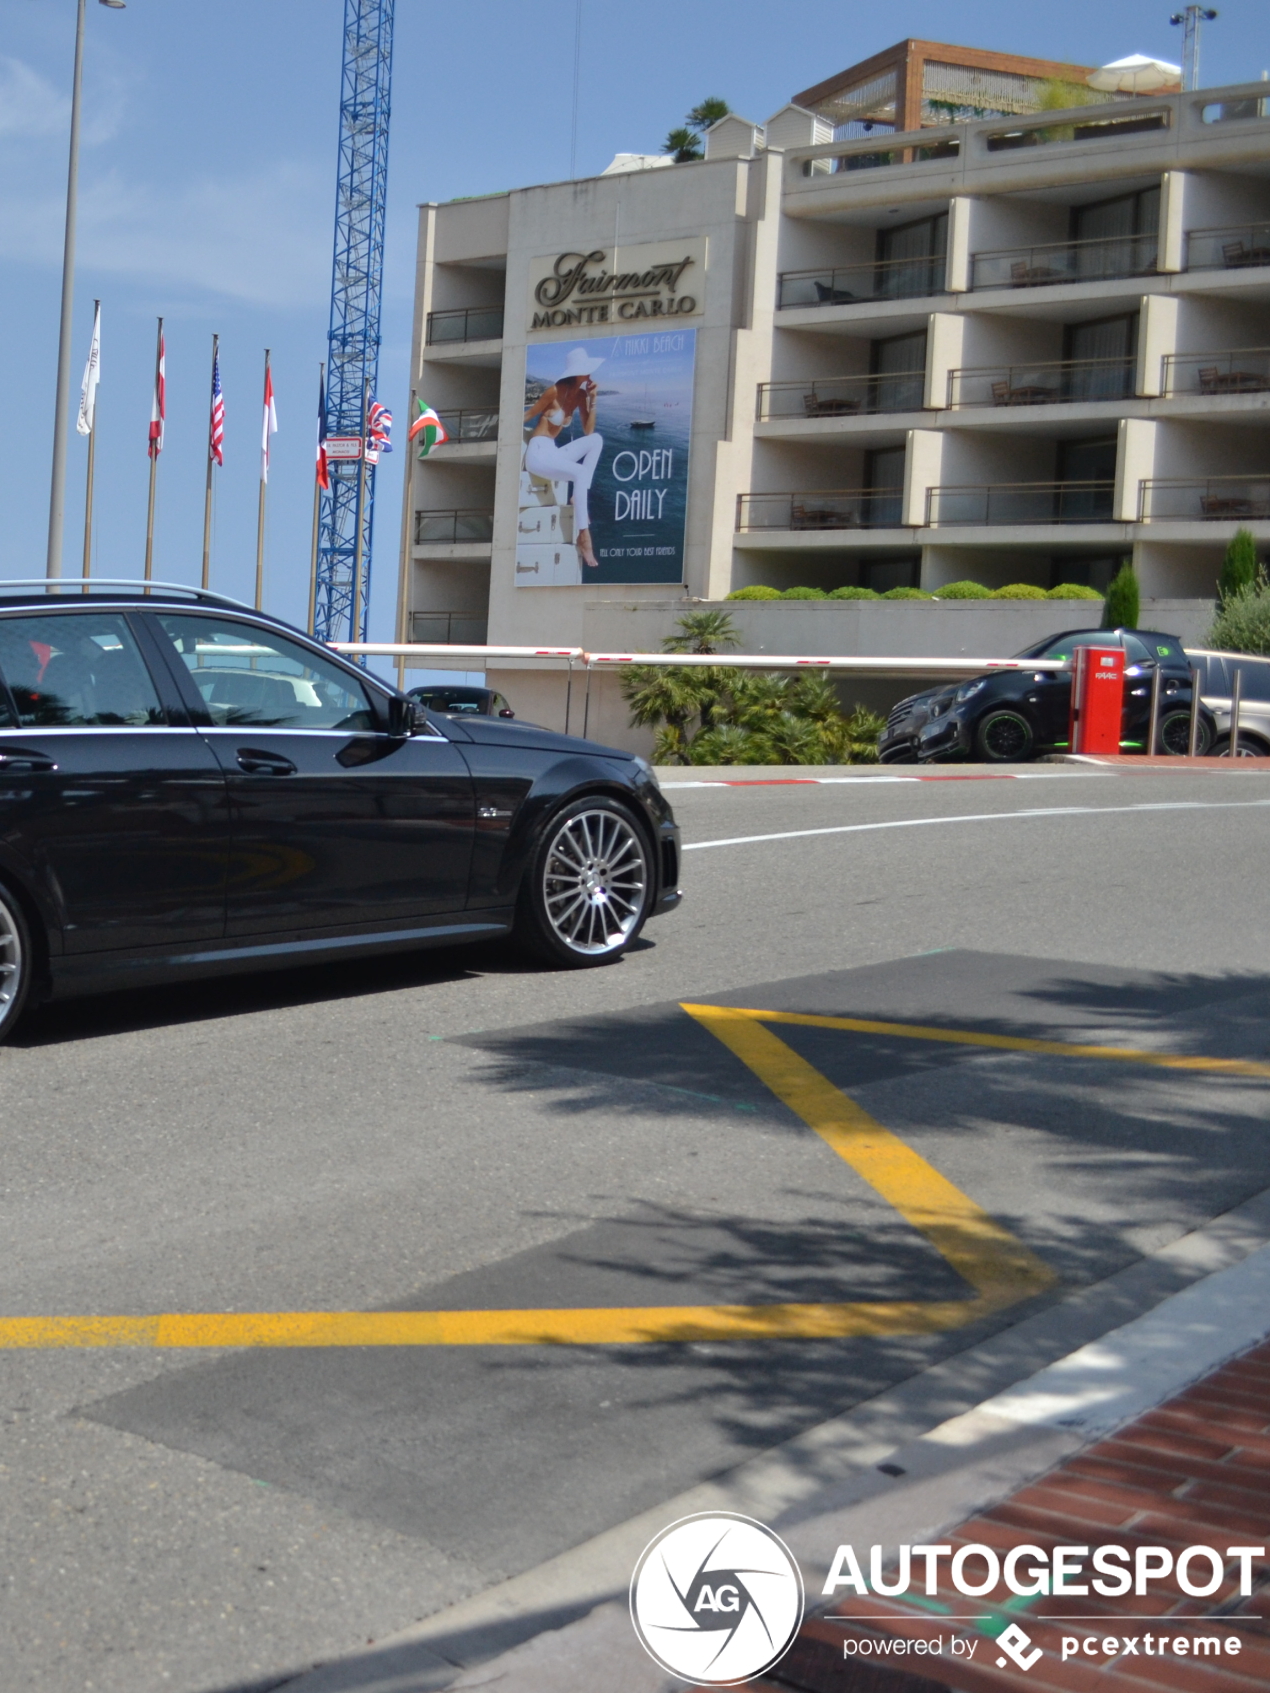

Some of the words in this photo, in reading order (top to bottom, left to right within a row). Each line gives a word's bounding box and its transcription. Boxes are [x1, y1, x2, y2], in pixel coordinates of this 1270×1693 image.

[534, 250, 695, 307] Fairmont
[531, 304, 609, 329] MONTE
[617, 295, 696, 319] CARLO
[625, 338, 649, 355] NIKKI
[653, 335, 685, 353] BEACH
[612, 448, 673, 482] OPEN
[615, 488, 668, 521] DAILY
[610, 547, 625, 557] ONLY
[626, 547, 642, 557] YOUR
[643, 546, 655, 556] BEST
[655, 546, 676, 556] FRIENDS
[1095, 672, 1117, 680] FAAC
